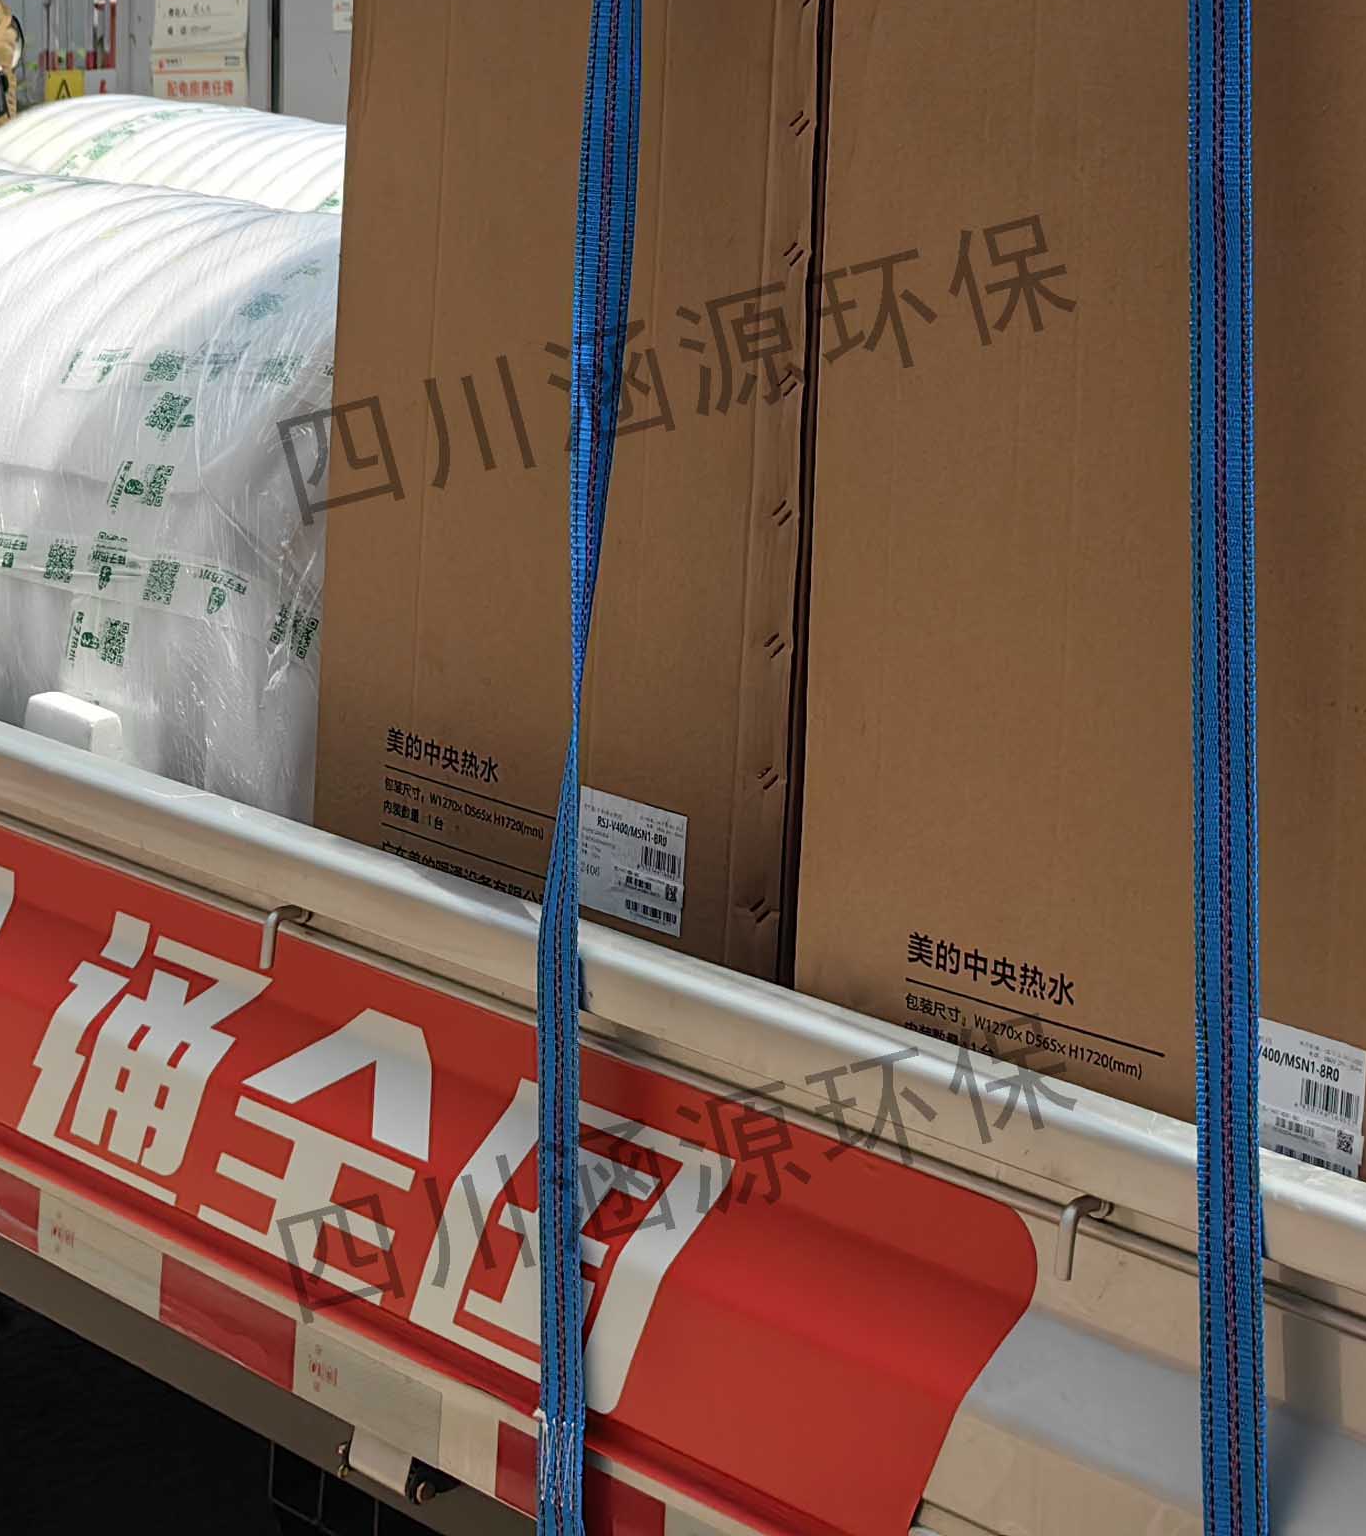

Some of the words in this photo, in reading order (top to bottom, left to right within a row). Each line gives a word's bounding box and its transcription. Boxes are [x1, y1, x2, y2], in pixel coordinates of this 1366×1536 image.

[386, 727, 499, 783] 美的中央热水
[907, 931, 1075, 1006] 美的中央热水
